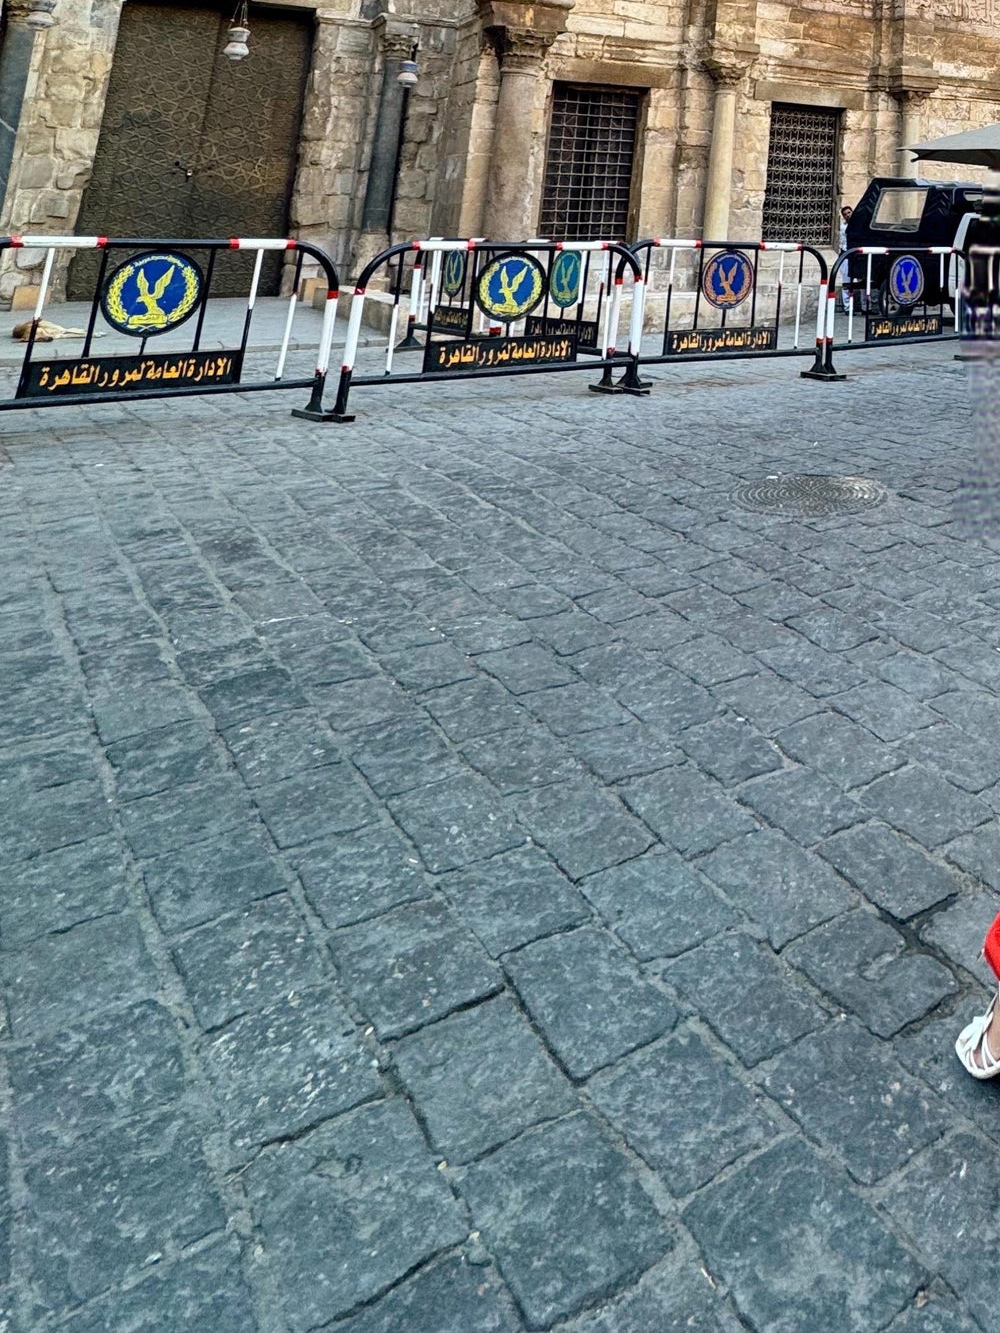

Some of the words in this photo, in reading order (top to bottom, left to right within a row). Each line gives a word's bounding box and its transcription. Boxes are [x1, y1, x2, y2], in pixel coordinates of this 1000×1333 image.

[511, 341, 540, 359] العامة
[672, 332, 702, 353] القاهرة
[438, 344, 480, 368] القاهرة
[39, 364, 101, 391] القاهرة
[98, 362, 146, 388] لمرور
[146, 360, 187, 380] العامة
